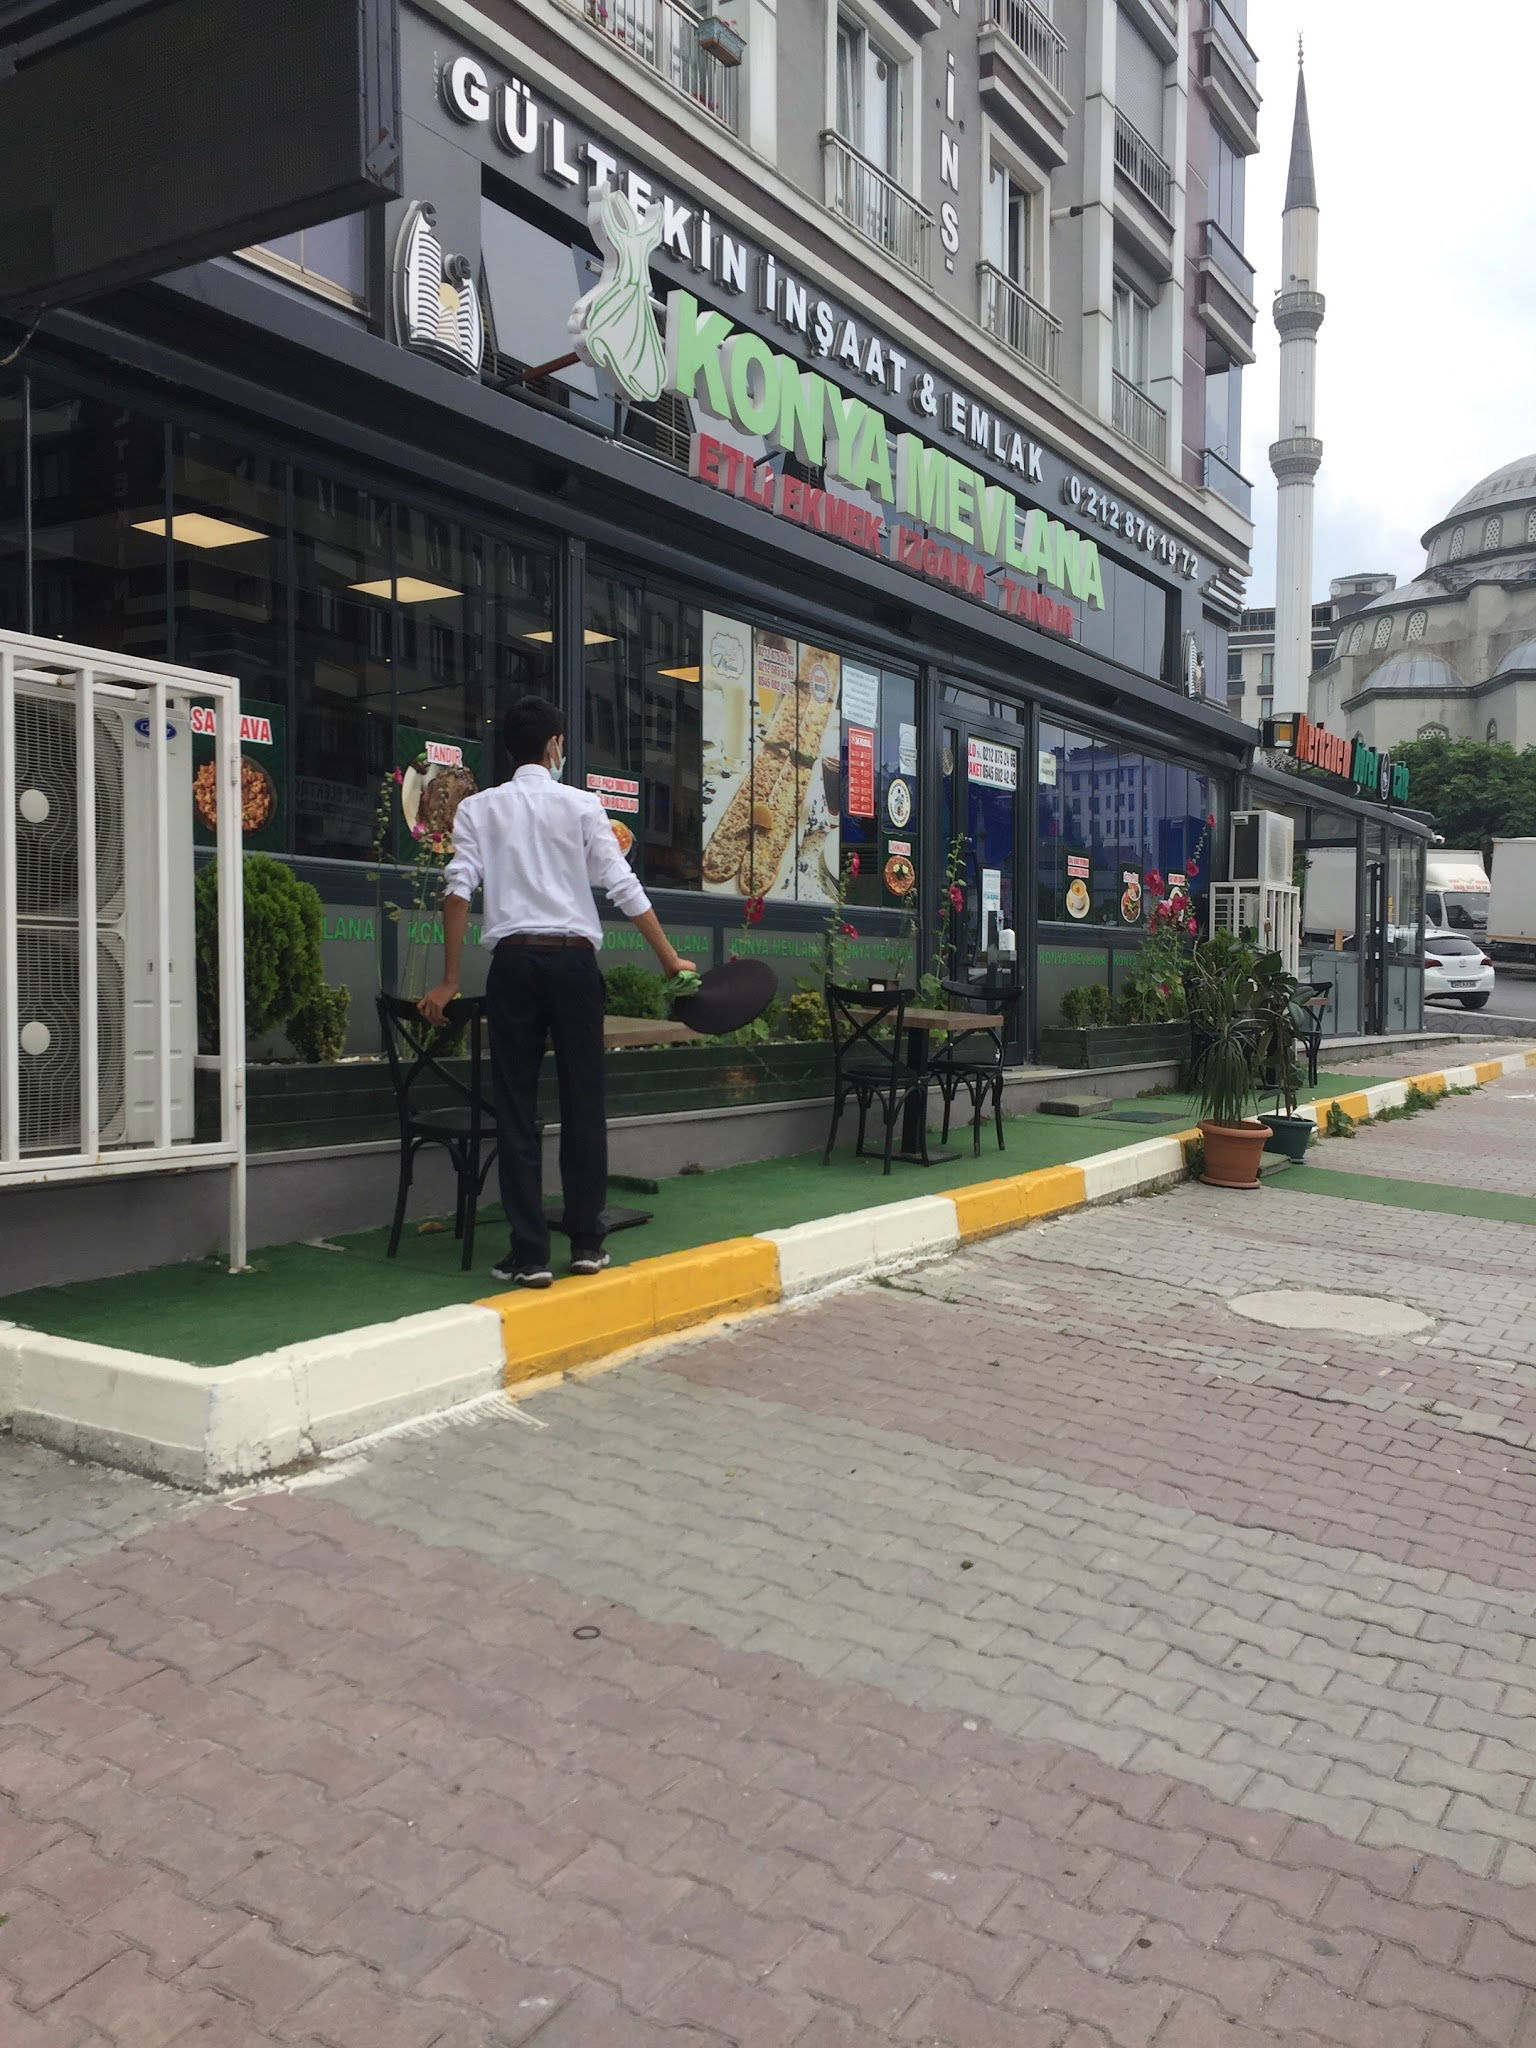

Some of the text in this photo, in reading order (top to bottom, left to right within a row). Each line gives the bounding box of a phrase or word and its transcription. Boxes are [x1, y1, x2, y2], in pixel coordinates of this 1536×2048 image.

[445, 57, 747, 295] GÜLTEKİN
[761, 254, 907, 395] İNŞAAT
[914, 373, 938, 417] &
[947, 392, 1044, 484] EMLAK
[668, 289, 1106, 611] KONYA MEVLANA
[689, 432, 775, 510] ETLİ
[774, 473, 884, 556] EKMEK
[428, 744, 461, 764] TANDIR
